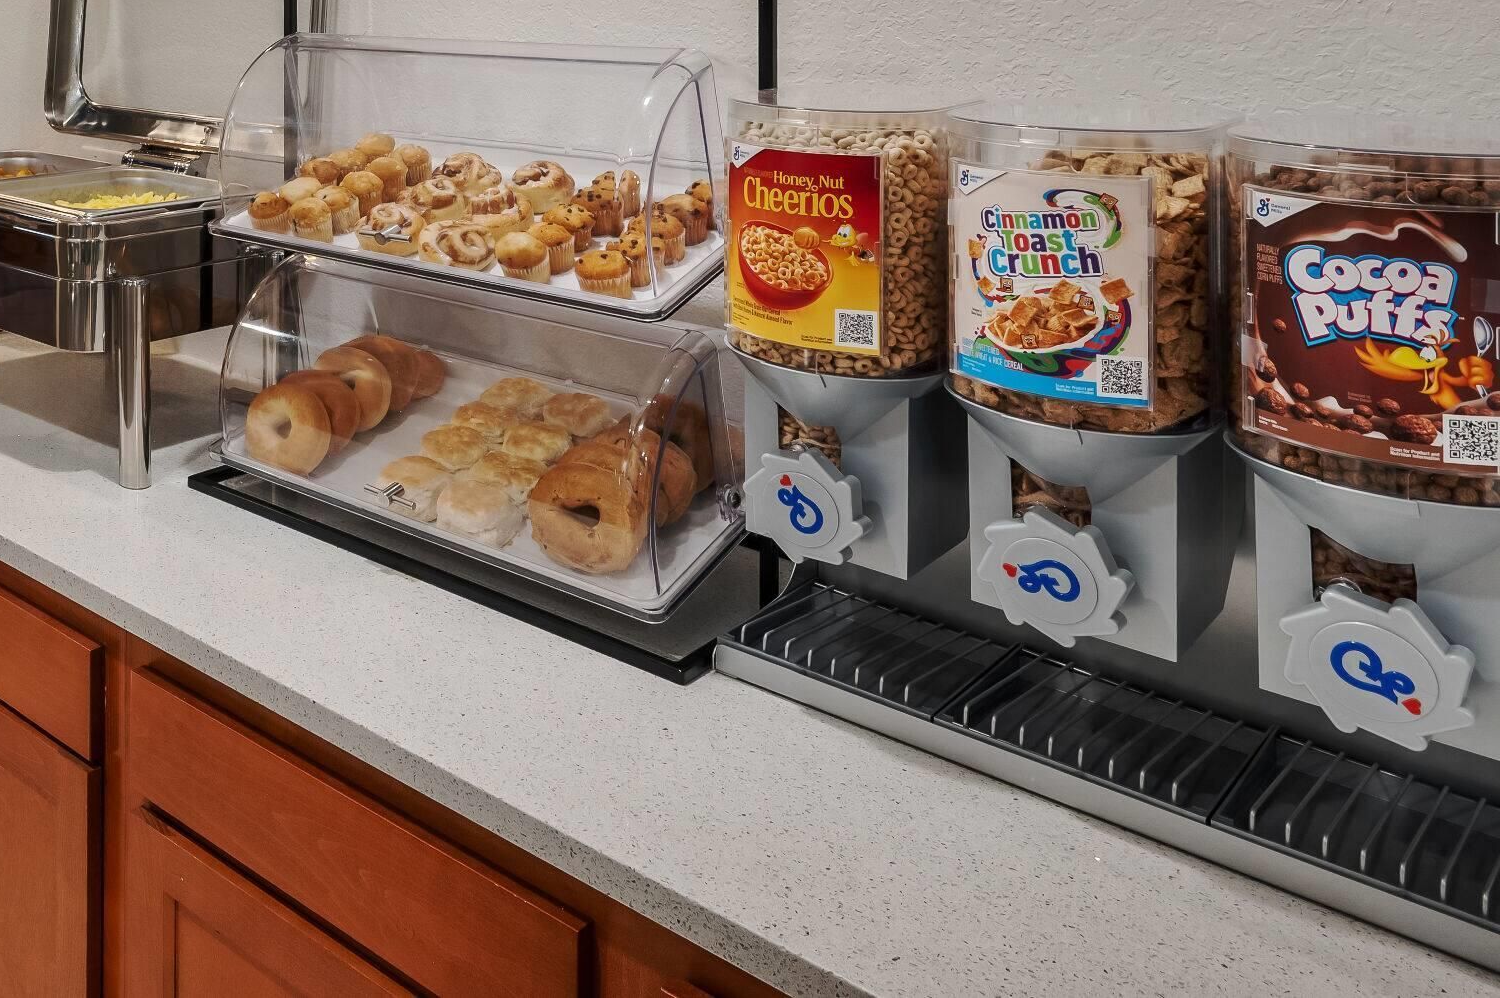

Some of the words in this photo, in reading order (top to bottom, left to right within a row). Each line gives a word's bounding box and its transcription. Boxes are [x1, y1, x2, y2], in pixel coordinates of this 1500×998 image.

[773, 170, 814, 190] Honey
[819, 175, 845, 190] Nut
[743, 176, 854, 219] Cheerios
[984, 207, 1098, 230] Cinnamon
[1000, 229, 1077, 253] Toast
[1256, 243, 1280, 256] NATURALLY
[990, 245, 1101, 275] Crunch
[1268, 273, 1283, 285] PUFFS
[1288, 248, 1454, 304] Cocoa
[1296, 290, 1452, 345] Puffs
[1003, 359, 1024, 371] CEREAL
